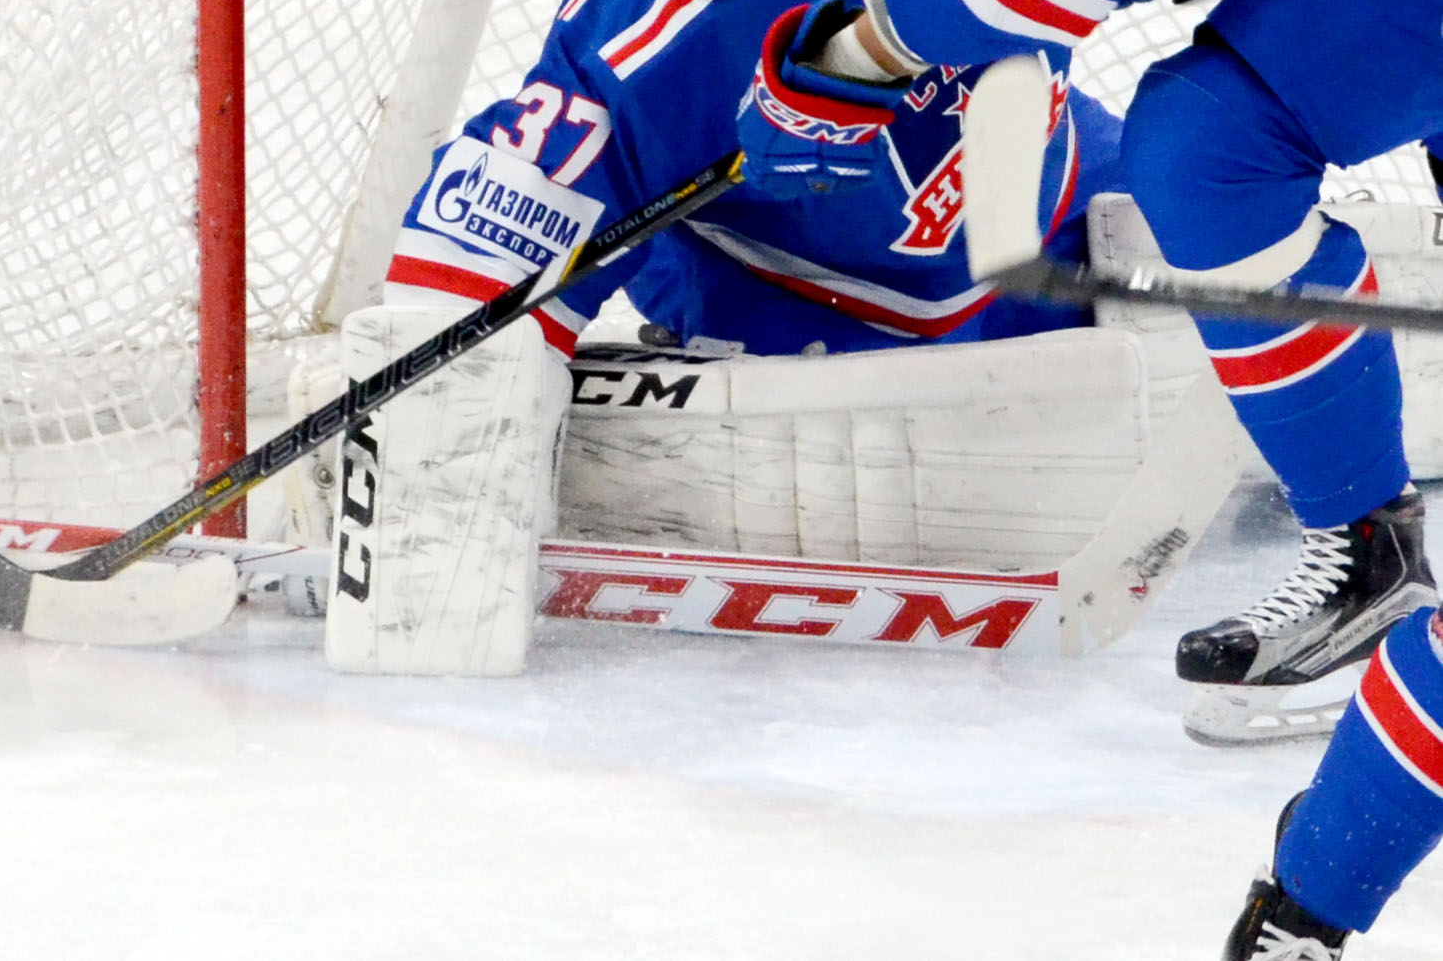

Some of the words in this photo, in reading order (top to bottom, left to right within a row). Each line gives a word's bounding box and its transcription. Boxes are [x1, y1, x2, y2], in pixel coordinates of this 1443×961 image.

[492, 81, 612, 188] 37
[468, 217, 550, 264] ЭКСПОР
[476, 178, 581, 249] ГАЗПРОМ
[570, 369, 702, 409] CM
[538, 567, 1042, 651] CCM
